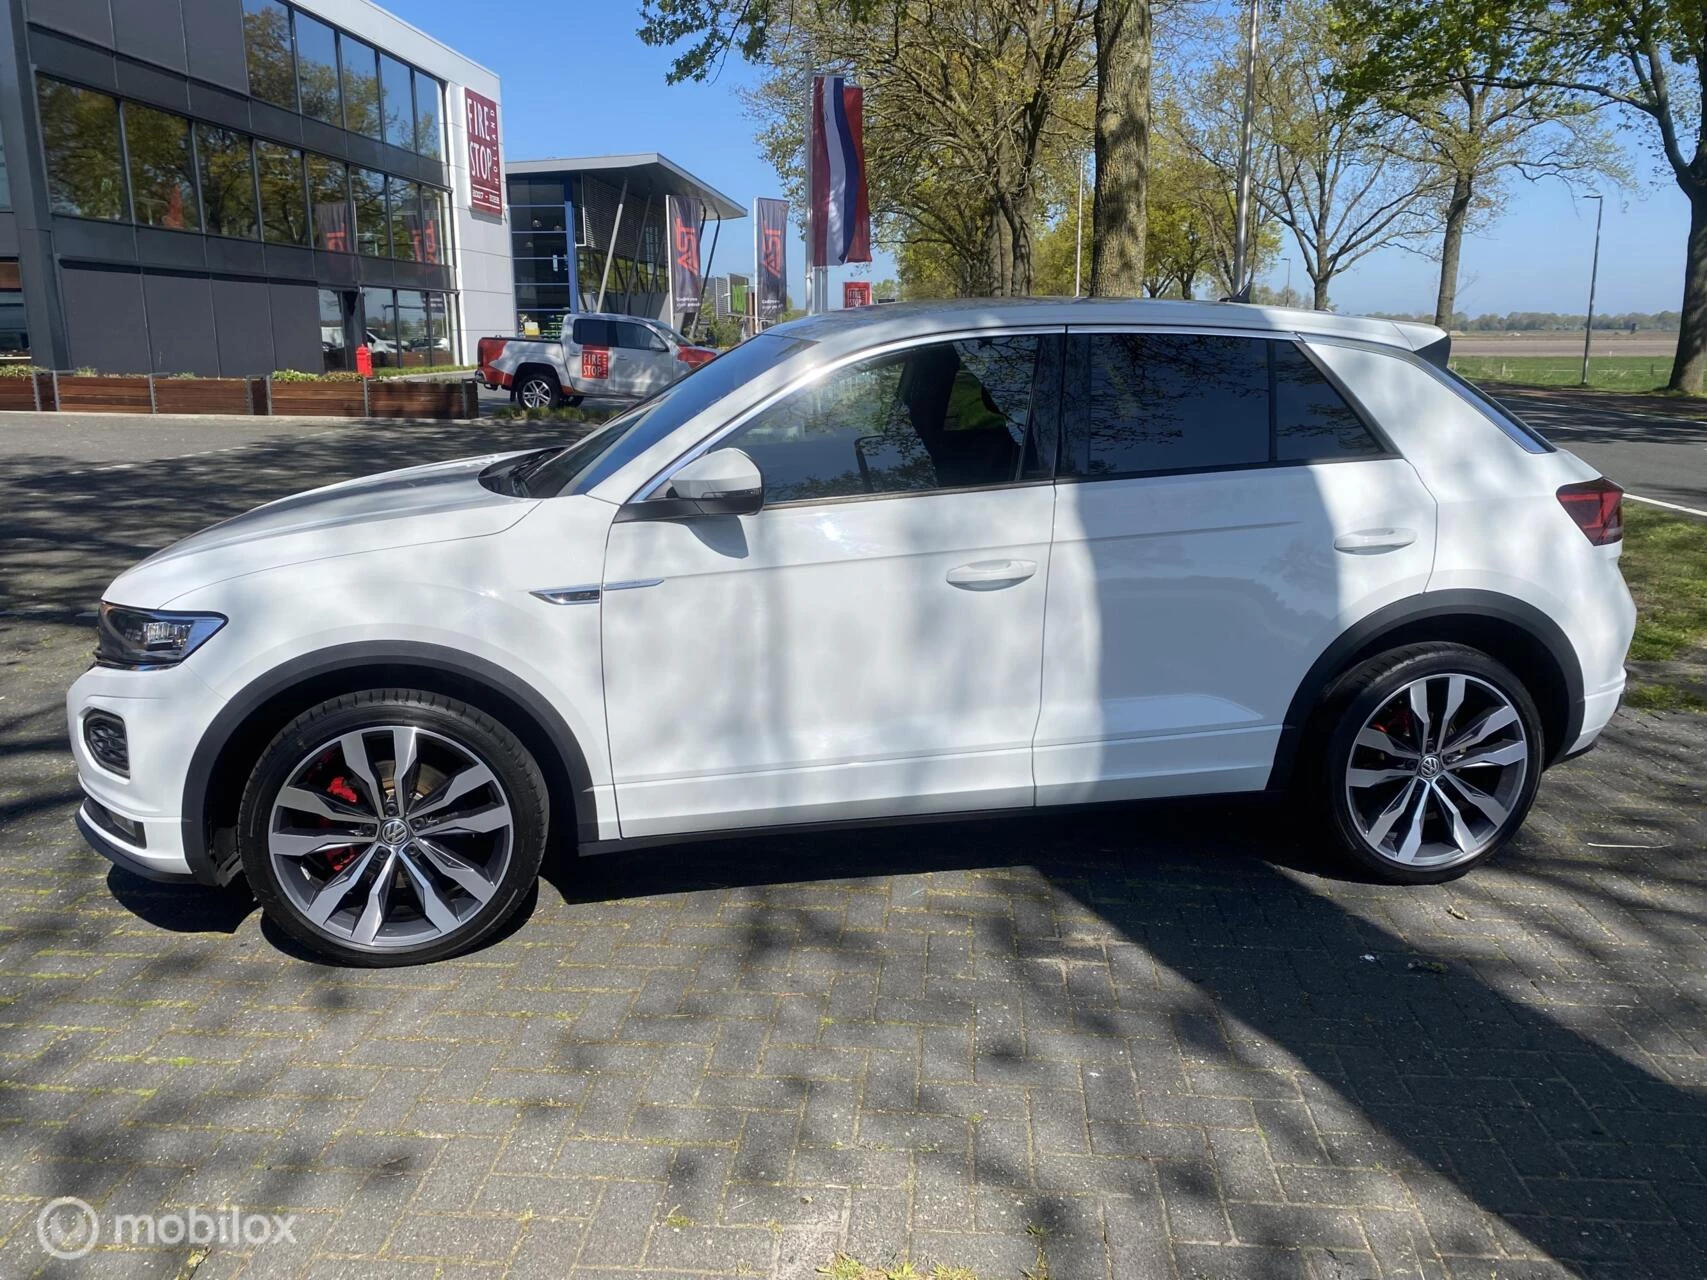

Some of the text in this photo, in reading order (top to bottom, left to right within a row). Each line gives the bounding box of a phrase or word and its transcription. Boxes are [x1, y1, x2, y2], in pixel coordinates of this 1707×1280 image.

[467, 98, 490, 141] FIRE
[470, 141, 492, 181] STOP
[490, 109, 499, 184] HOLLAND
[583, 354, 601, 365] FIRE
[583, 365, 601, 376] STOP
